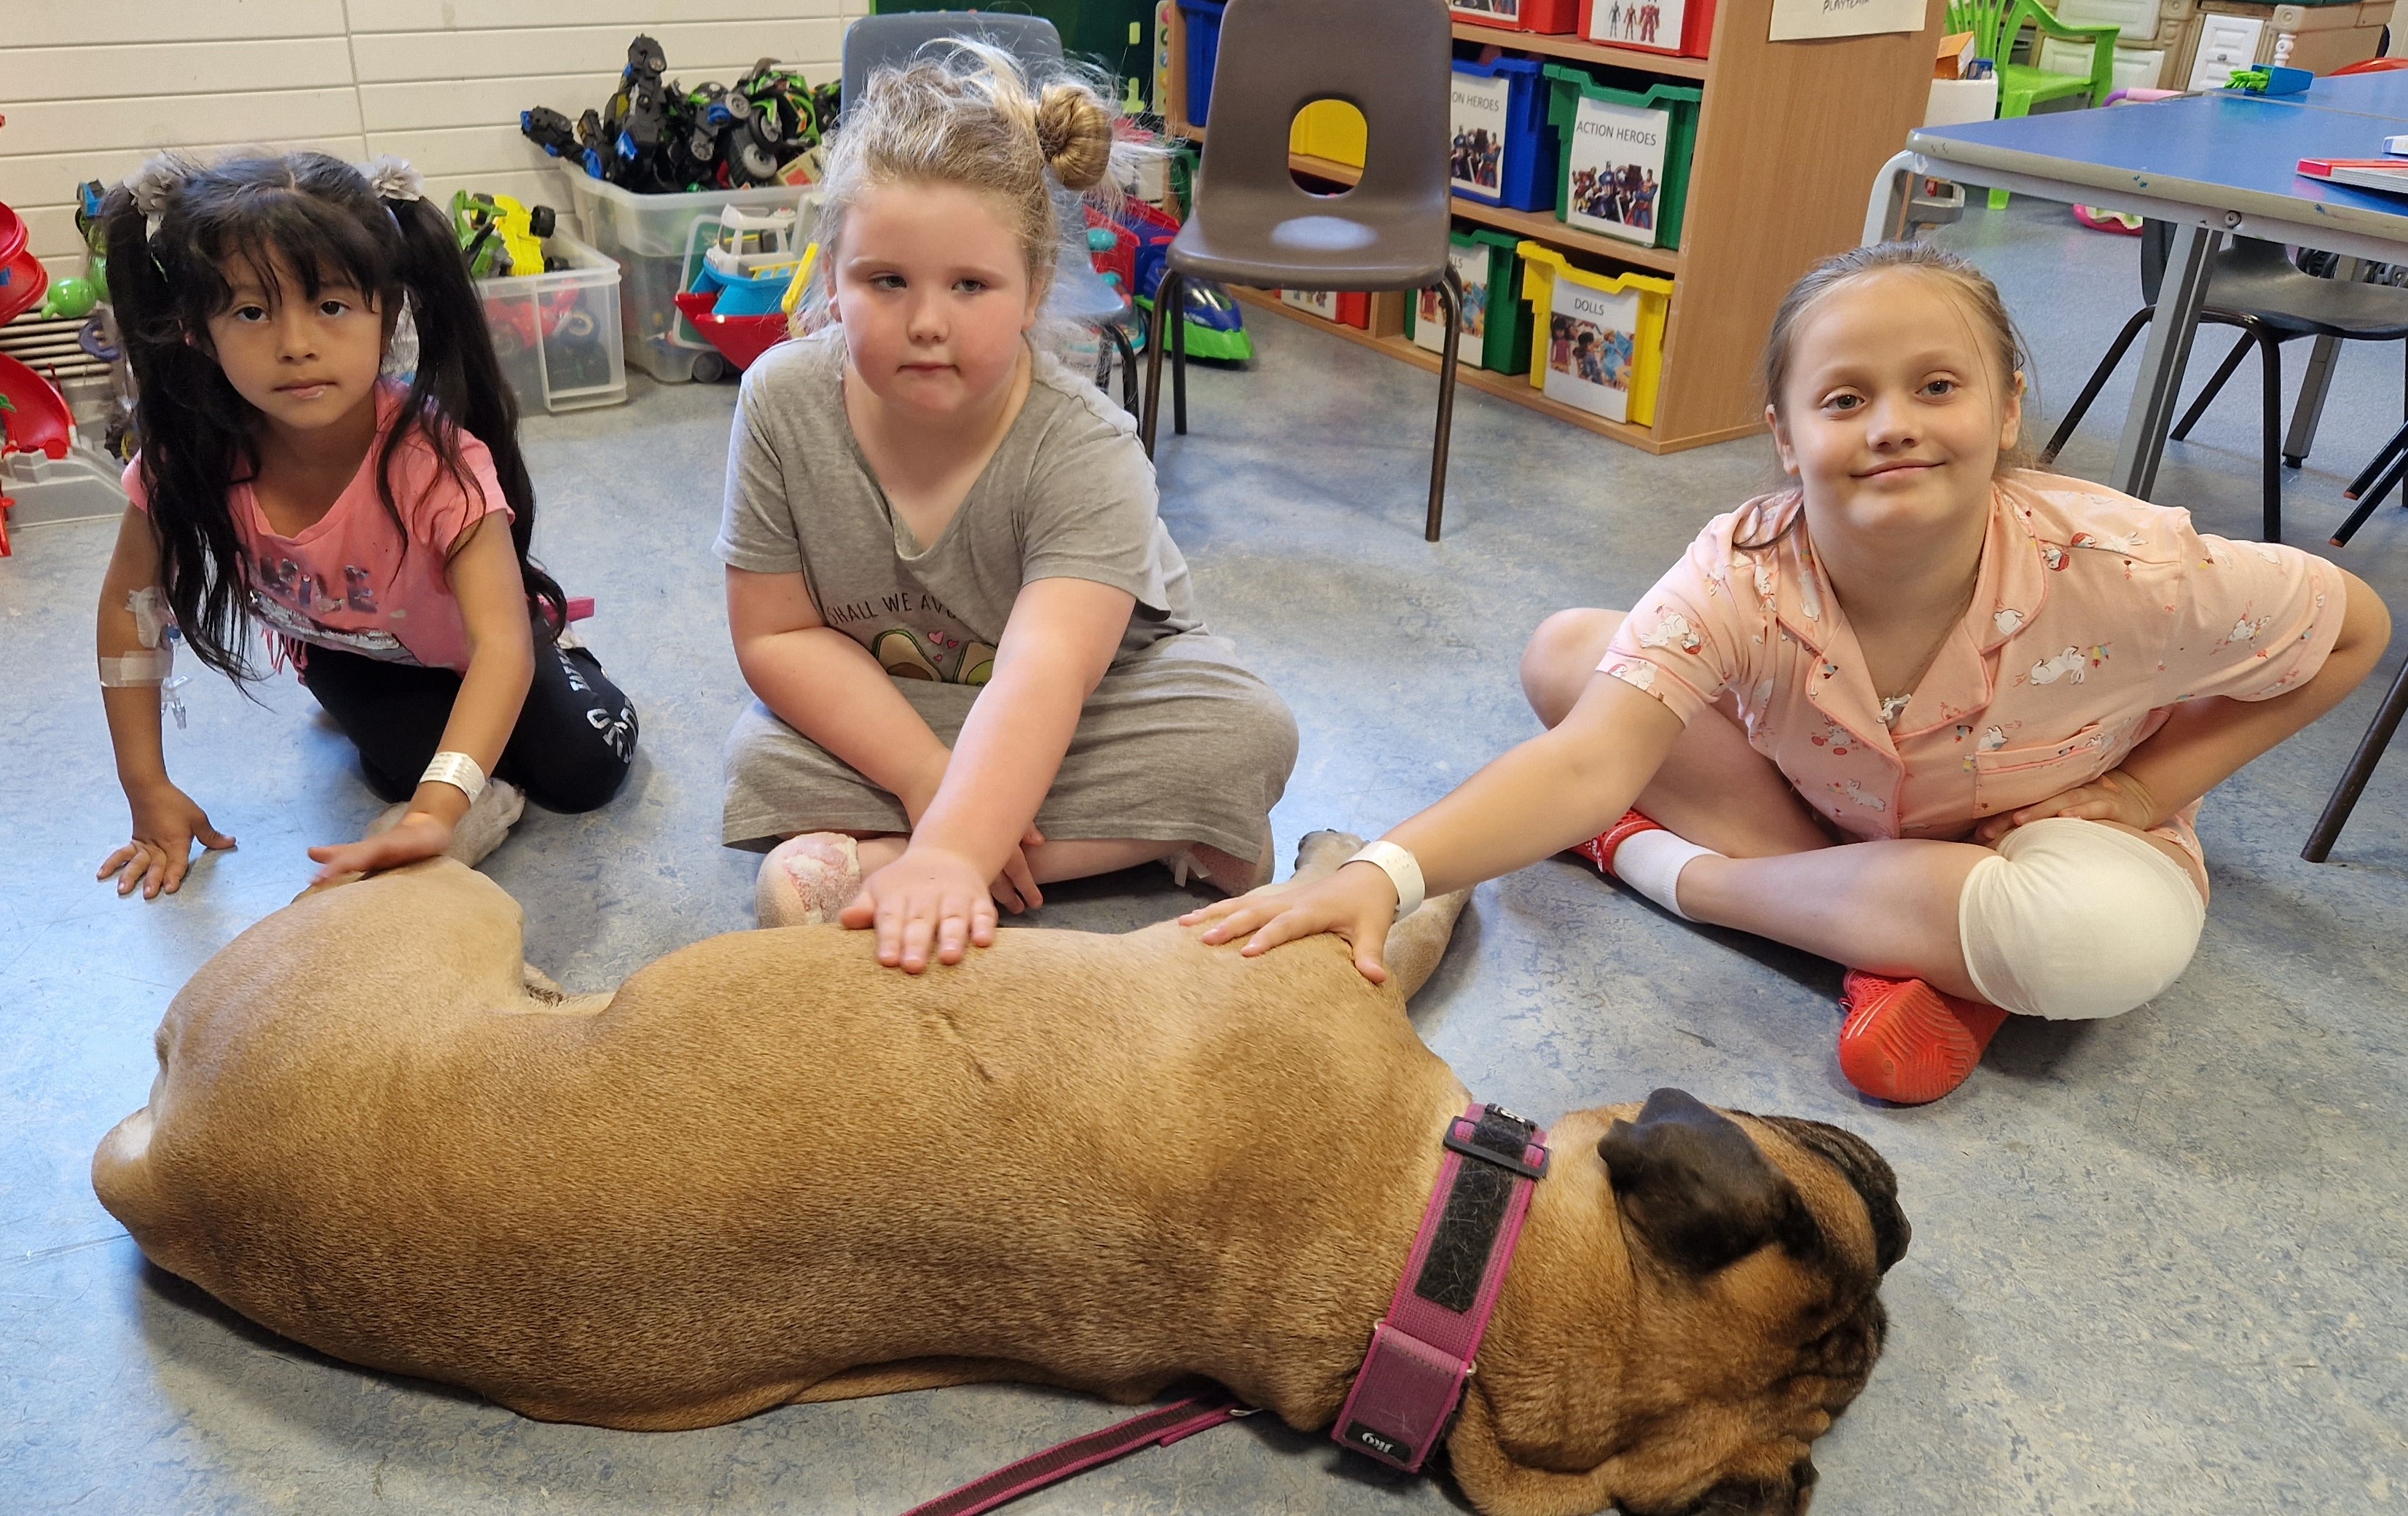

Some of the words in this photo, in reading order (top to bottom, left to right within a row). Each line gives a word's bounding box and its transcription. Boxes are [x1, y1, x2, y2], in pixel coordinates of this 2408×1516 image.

[1467, 95, 1499, 112] HEROES
[1576, 120, 1614, 138] ACTION
[1616, 127, 1657, 146] HEROES
[1574, 298, 1604, 315] DOLLS
[827, 600, 879, 625] SHALL
[882, 592, 912, 613] WE
